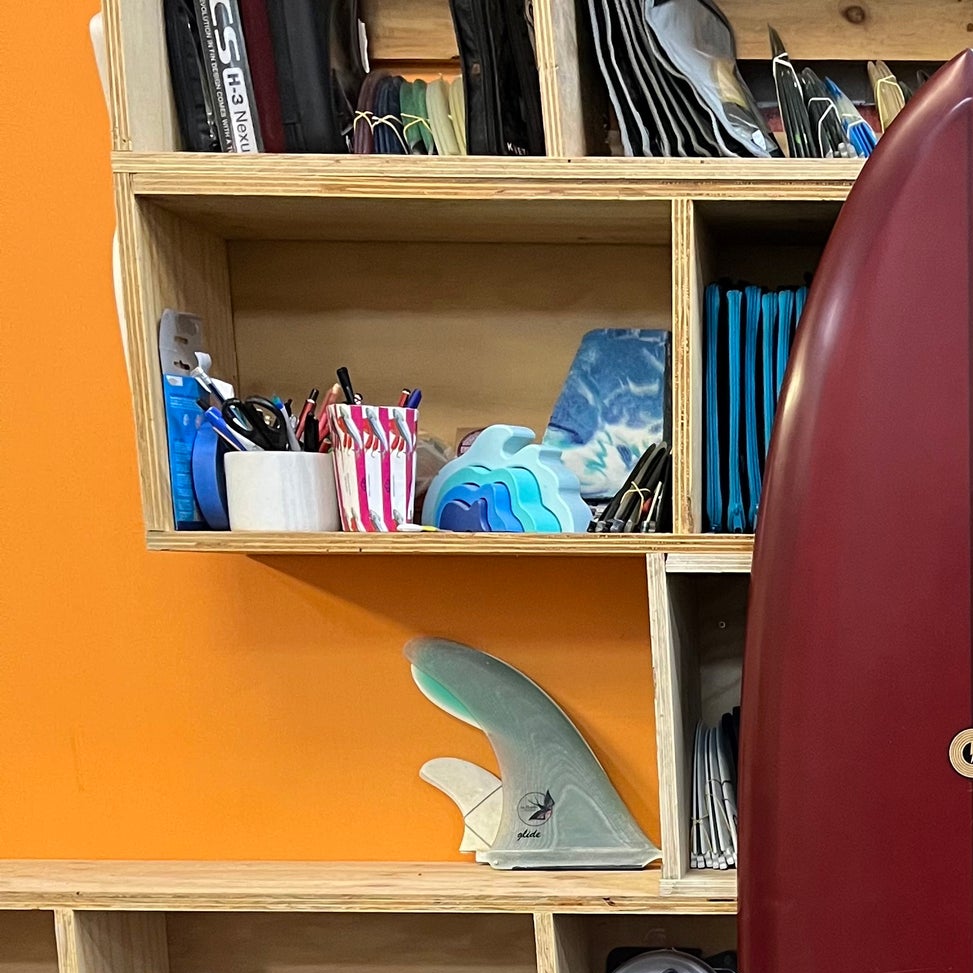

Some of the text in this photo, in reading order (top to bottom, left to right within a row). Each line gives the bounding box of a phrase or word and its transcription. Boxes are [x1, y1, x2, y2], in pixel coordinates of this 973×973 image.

[227, 73, 244, 106] H-3
[216, 91, 227, 118] COMES
[222, 118, 231, 138] WITH
[516, 829, 541, 841] glide
